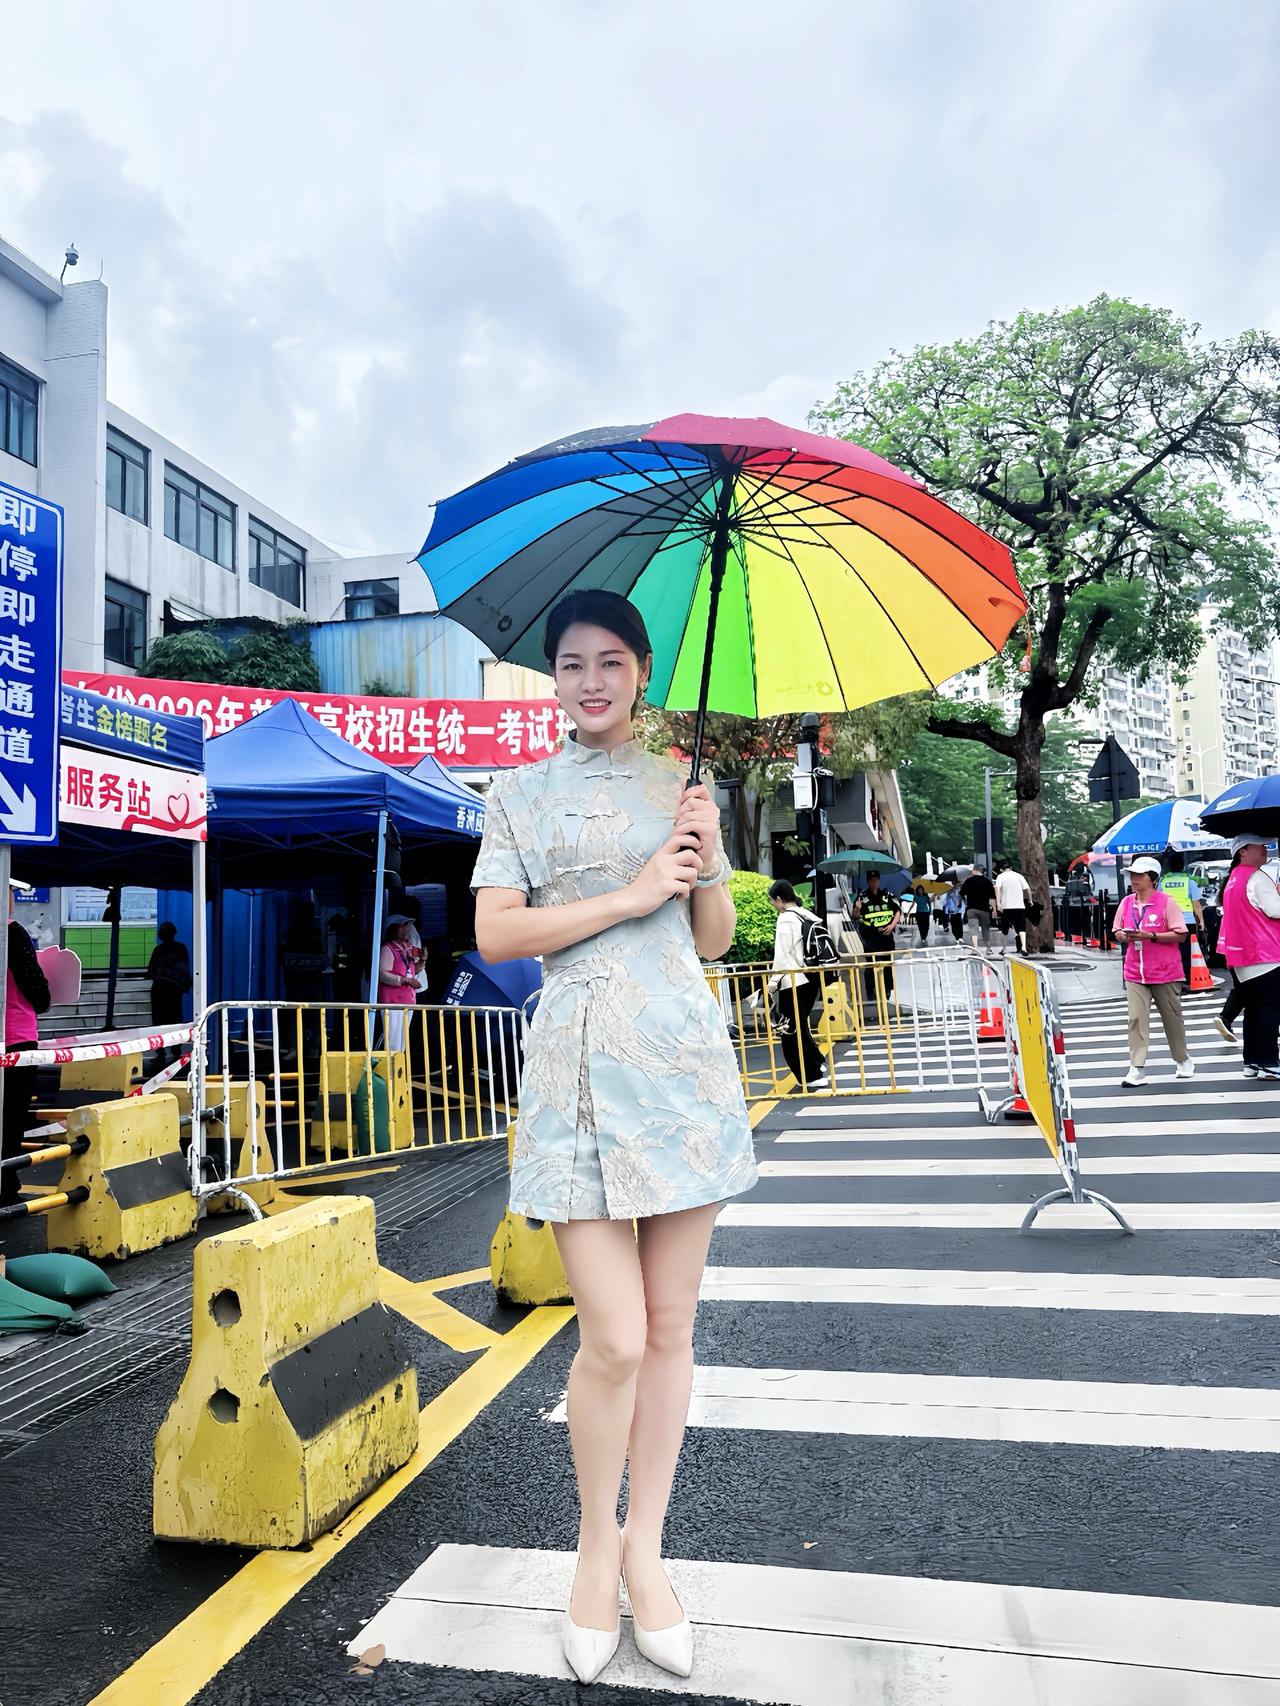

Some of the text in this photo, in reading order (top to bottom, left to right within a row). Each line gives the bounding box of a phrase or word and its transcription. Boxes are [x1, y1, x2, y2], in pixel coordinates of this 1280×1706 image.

[0, 491, 38, 764] 即停即走通道
[77, 680, 578, 755] 26年高校招生统一考试
[66, 765, 152, 817] 服务站
